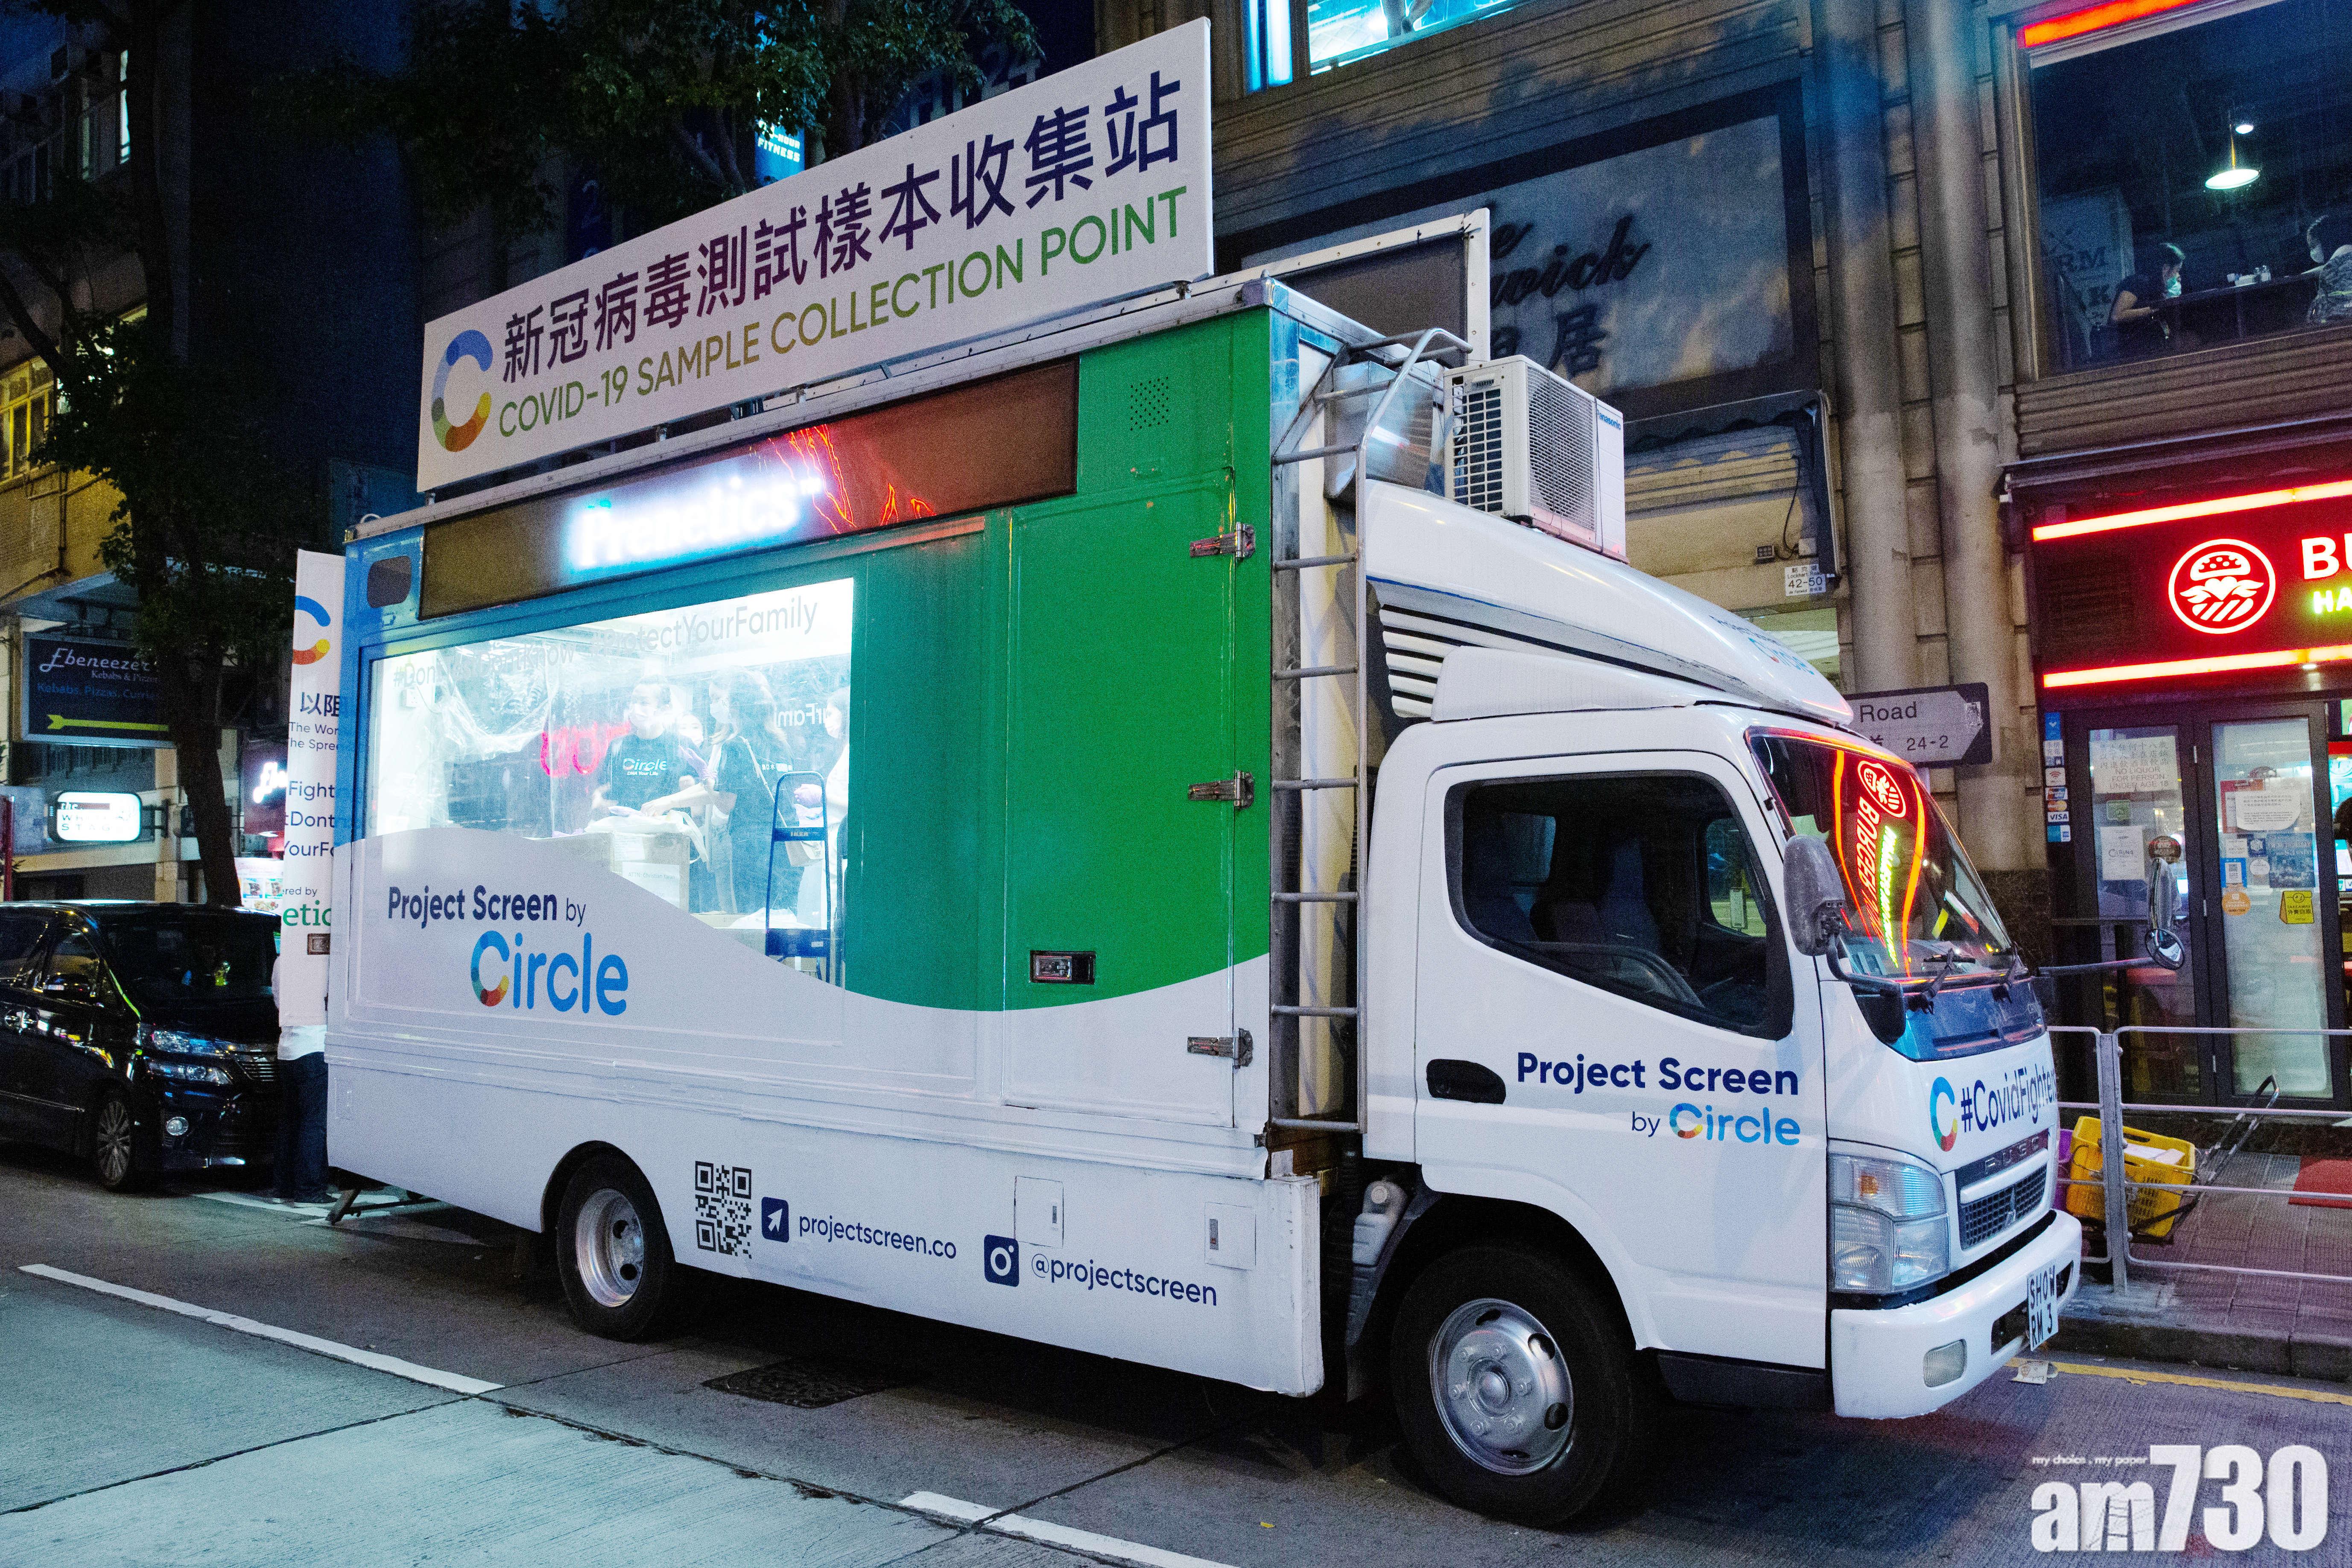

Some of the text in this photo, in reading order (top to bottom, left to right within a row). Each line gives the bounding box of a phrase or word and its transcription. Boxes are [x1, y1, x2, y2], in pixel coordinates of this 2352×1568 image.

[757, 137, 801, 163] FITNESS
[503, 70, 1180, 383] 新冠病毒測試樣本收集站
[499, 185, 1187, 438] COVID-19 SAMPLE COLLECTION POINT
[579, 476, 797, 567] Prenetics
[2301, 532, 2352, 580] B
[1788, 576, 1822, 588] 42-50
[589, 595, 818, 657] #ProtectYourFamily
[91, 669, 122, 680] Kebabs
[289, 722, 310, 733] The
[1859, 701, 1917, 723] Road
[288, 737, 304, 748] he
[622, 757, 668, 772] Circle
[1906, 735, 1949, 752] 24-2
[289, 780, 336, 801] Fight
[2130, 773, 2165, 781] PERSON
[305, 887, 317, 897] by
[388, 885, 586, 929] Project Screen by
[470, 930, 629, 1016] Circle
[1517, 1052, 1799, 1096] Project Screen
[1631, 1102, 1801, 1146] by Circle
[799, 1212, 957, 1260] projectscreen.co
[1031, 1252, 1217, 1307] @projectscreen
[2030, 1264, 2056, 1310] SHOW
[2031, 1302, 2053, 1349] RM 3
